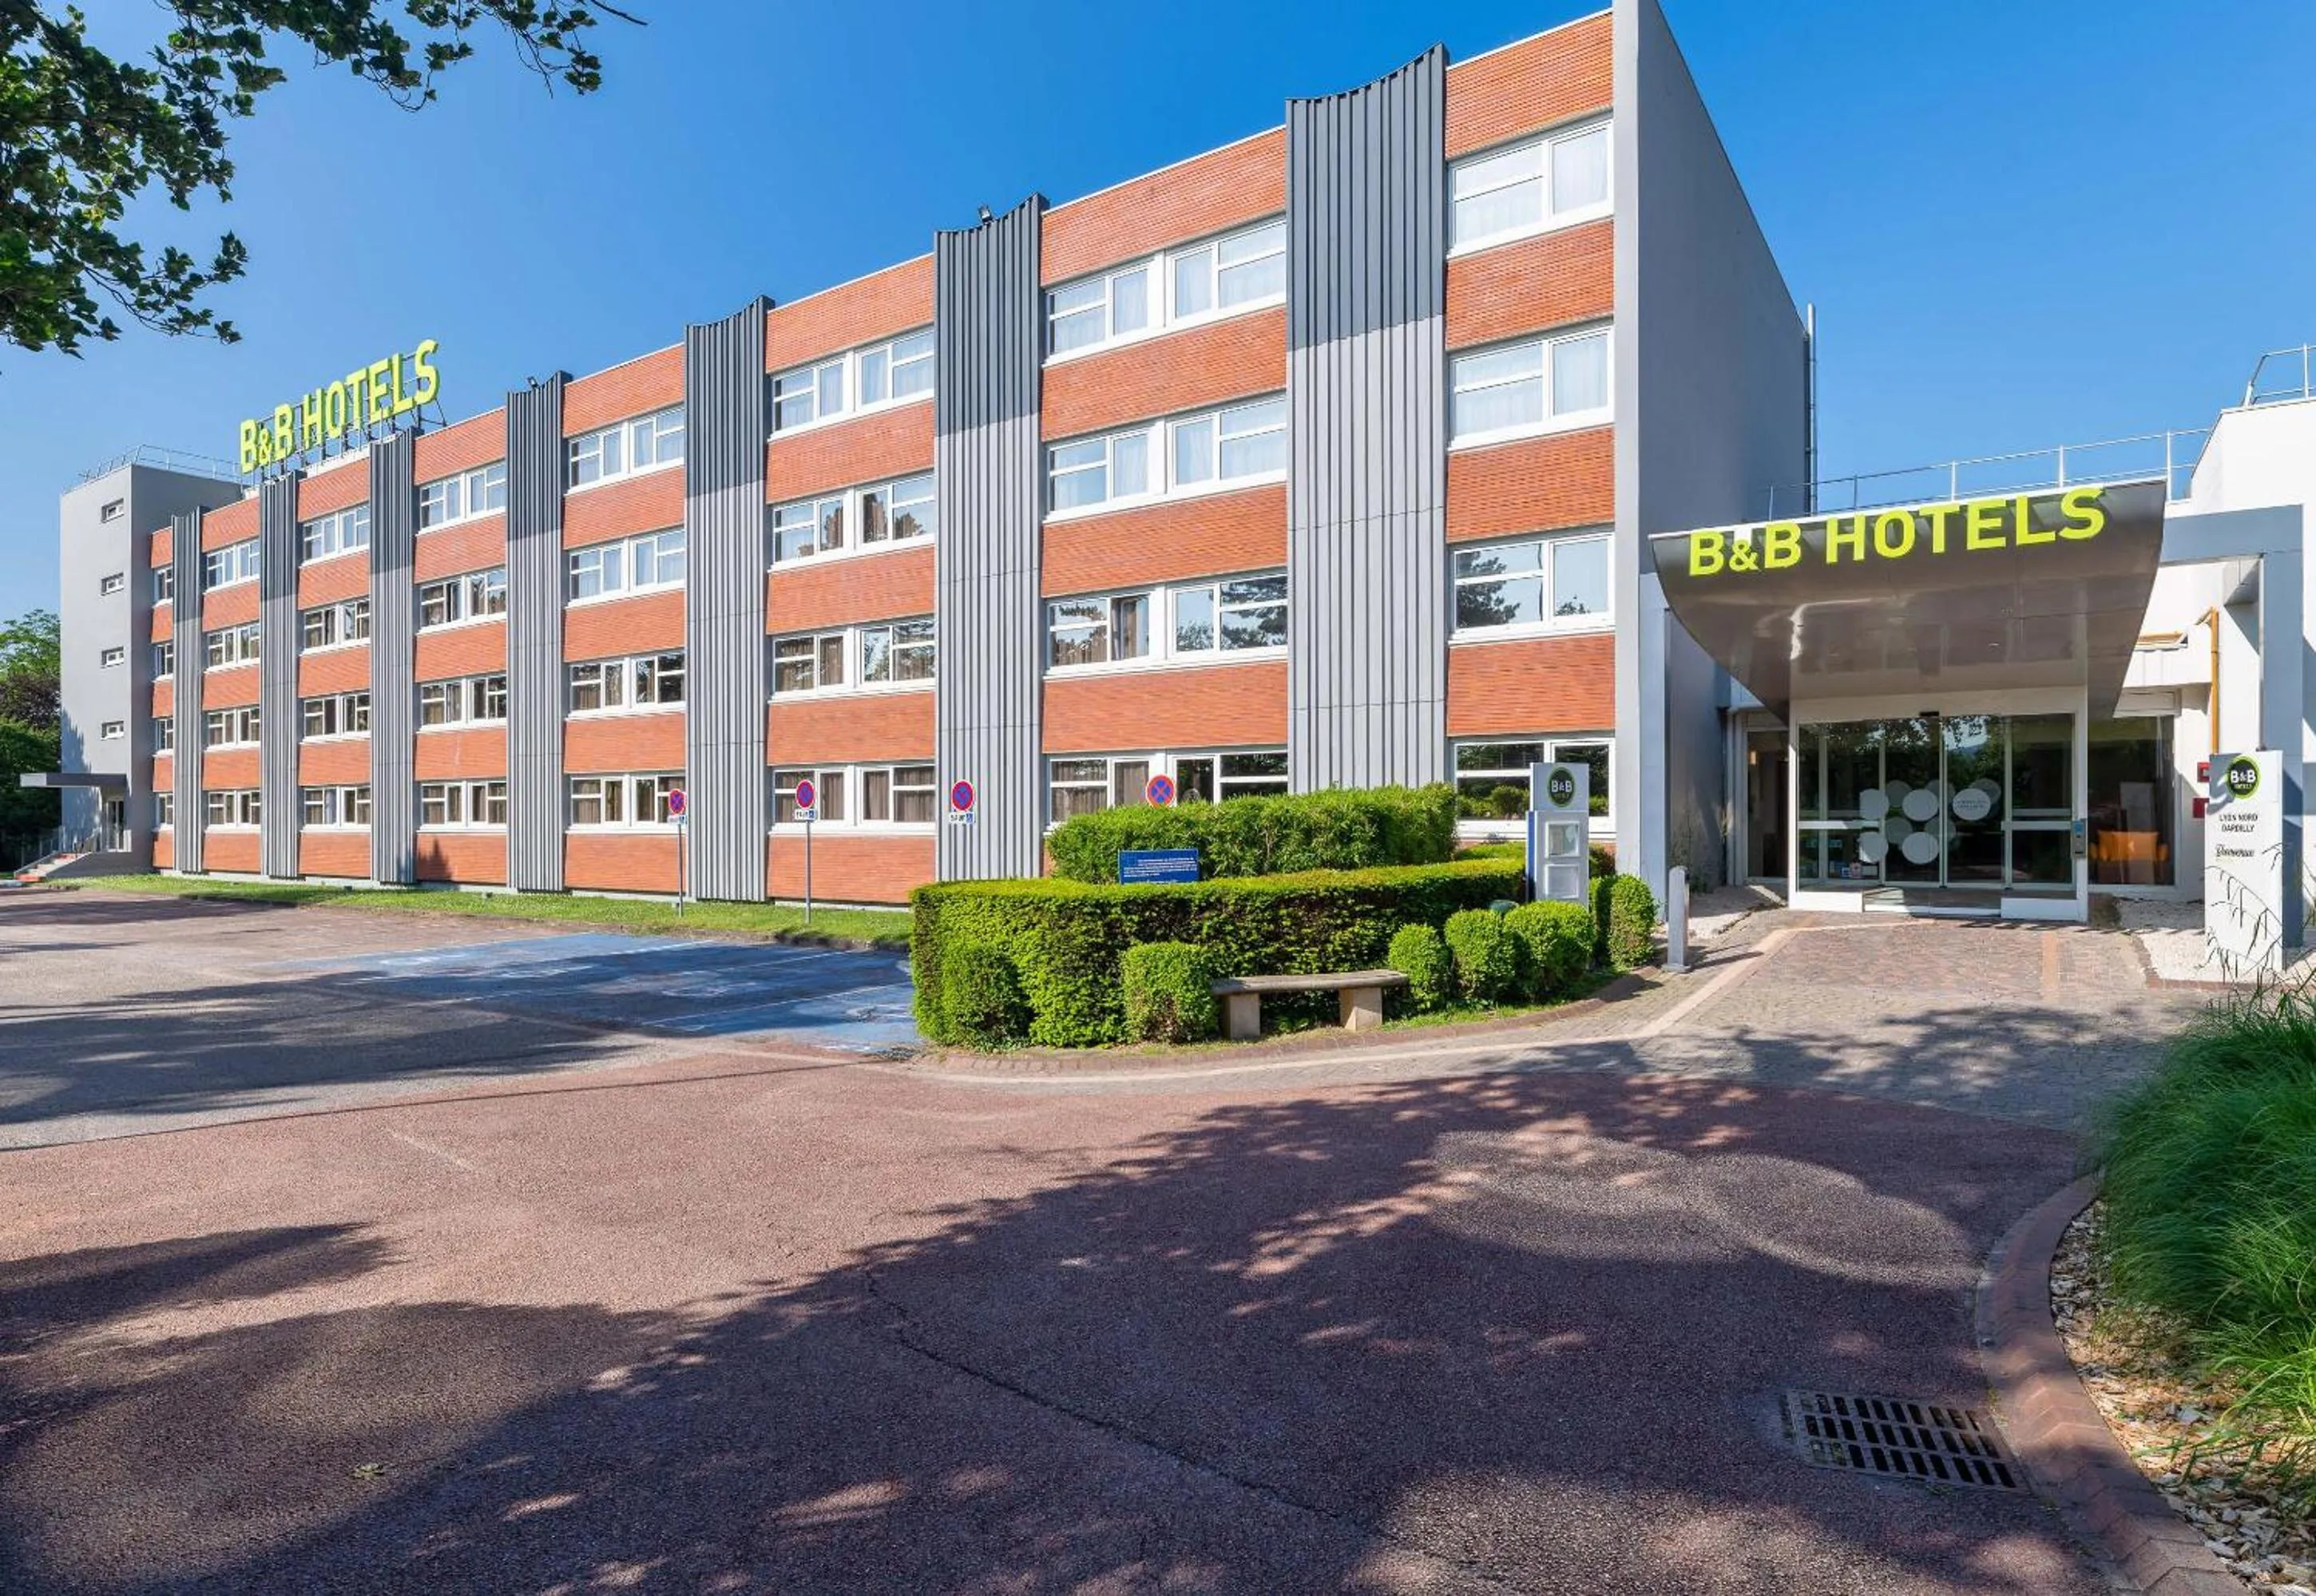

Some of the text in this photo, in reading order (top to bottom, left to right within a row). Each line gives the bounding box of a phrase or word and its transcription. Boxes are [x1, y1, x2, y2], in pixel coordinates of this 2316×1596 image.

[240, 339, 439, 474] B&B HOTELS
[1688, 486, 2107, 577] B&B HOTELS
[2231, 770, 2256, 783] B&B
[1551, 780, 1572, 793] B&B
[2238, 813, 2258, 822] NORD
